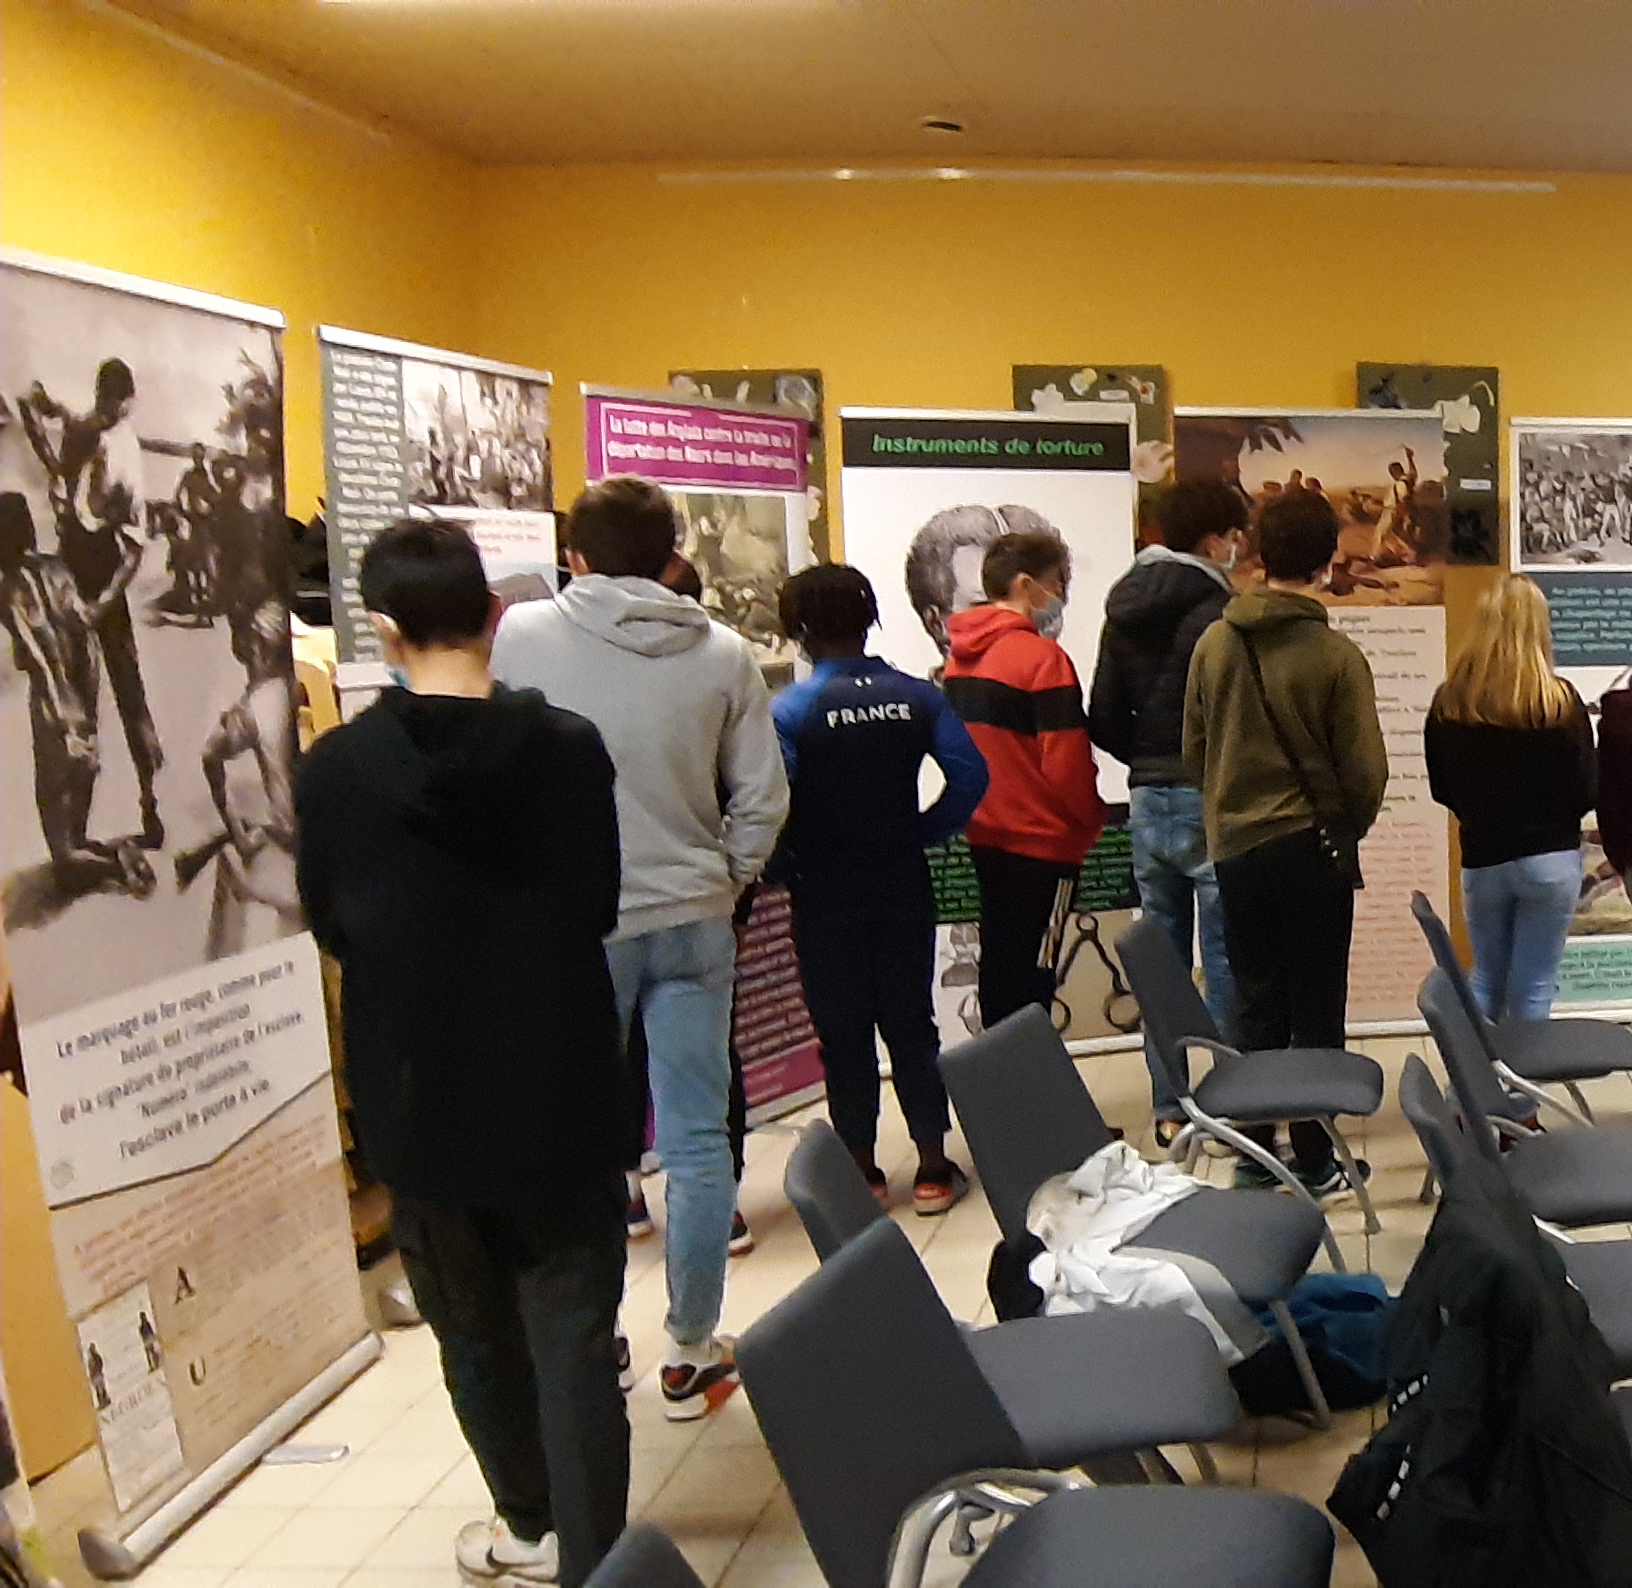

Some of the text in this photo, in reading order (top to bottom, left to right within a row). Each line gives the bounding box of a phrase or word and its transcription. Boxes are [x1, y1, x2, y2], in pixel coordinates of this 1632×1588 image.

[667, 419, 703, 442] Anglais
[703, 426, 732, 442] contre
[872, 434, 1104, 457] Instruments de torture
[826, 703, 911, 729] FRANCE
